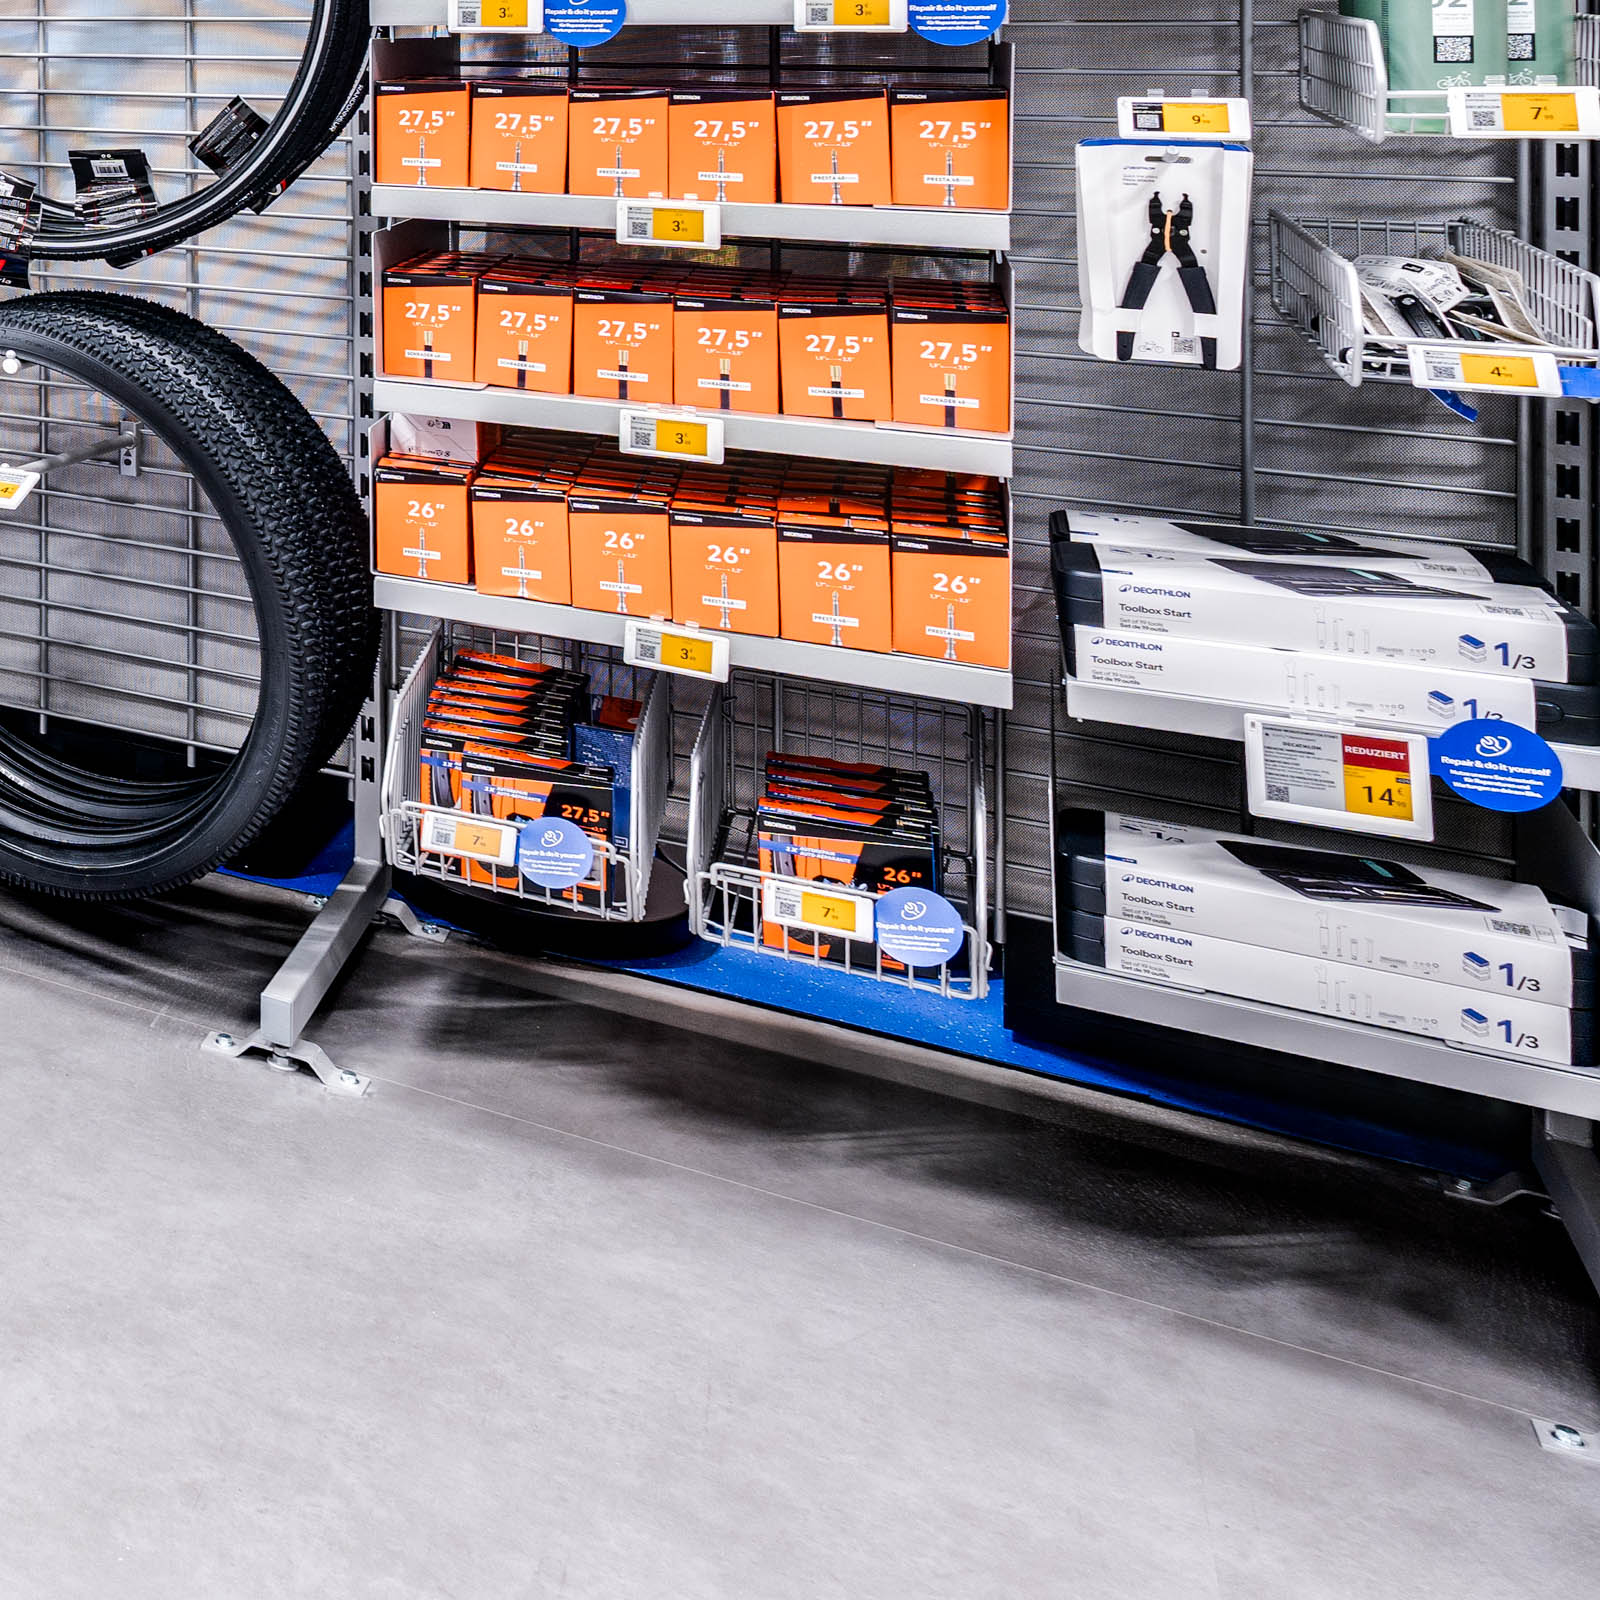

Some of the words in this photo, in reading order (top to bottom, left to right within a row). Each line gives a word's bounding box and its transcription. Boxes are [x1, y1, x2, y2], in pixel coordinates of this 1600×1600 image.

[1133, 586, 1191, 599] DECATHLON
[1119, 603, 1161, 615] Toolbox
[1163, 608, 1192, 618] Start
[1105, 638, 1162, 651] DECATHLON
[1091, 655, 1133, 667] Toolbox
[1135, 661, 1164, 671] Start
[1344, 745, 1407, 761] REDUZIERT
[1441, 756, 1474, 770] Repair
[1508, 762, 1552, 777] yourself
[1136, 876, 1194, 893] DECATHLON
[1122, 892, 1164, 907] Toolbox
[1166, 901, 1195, 913] Start
